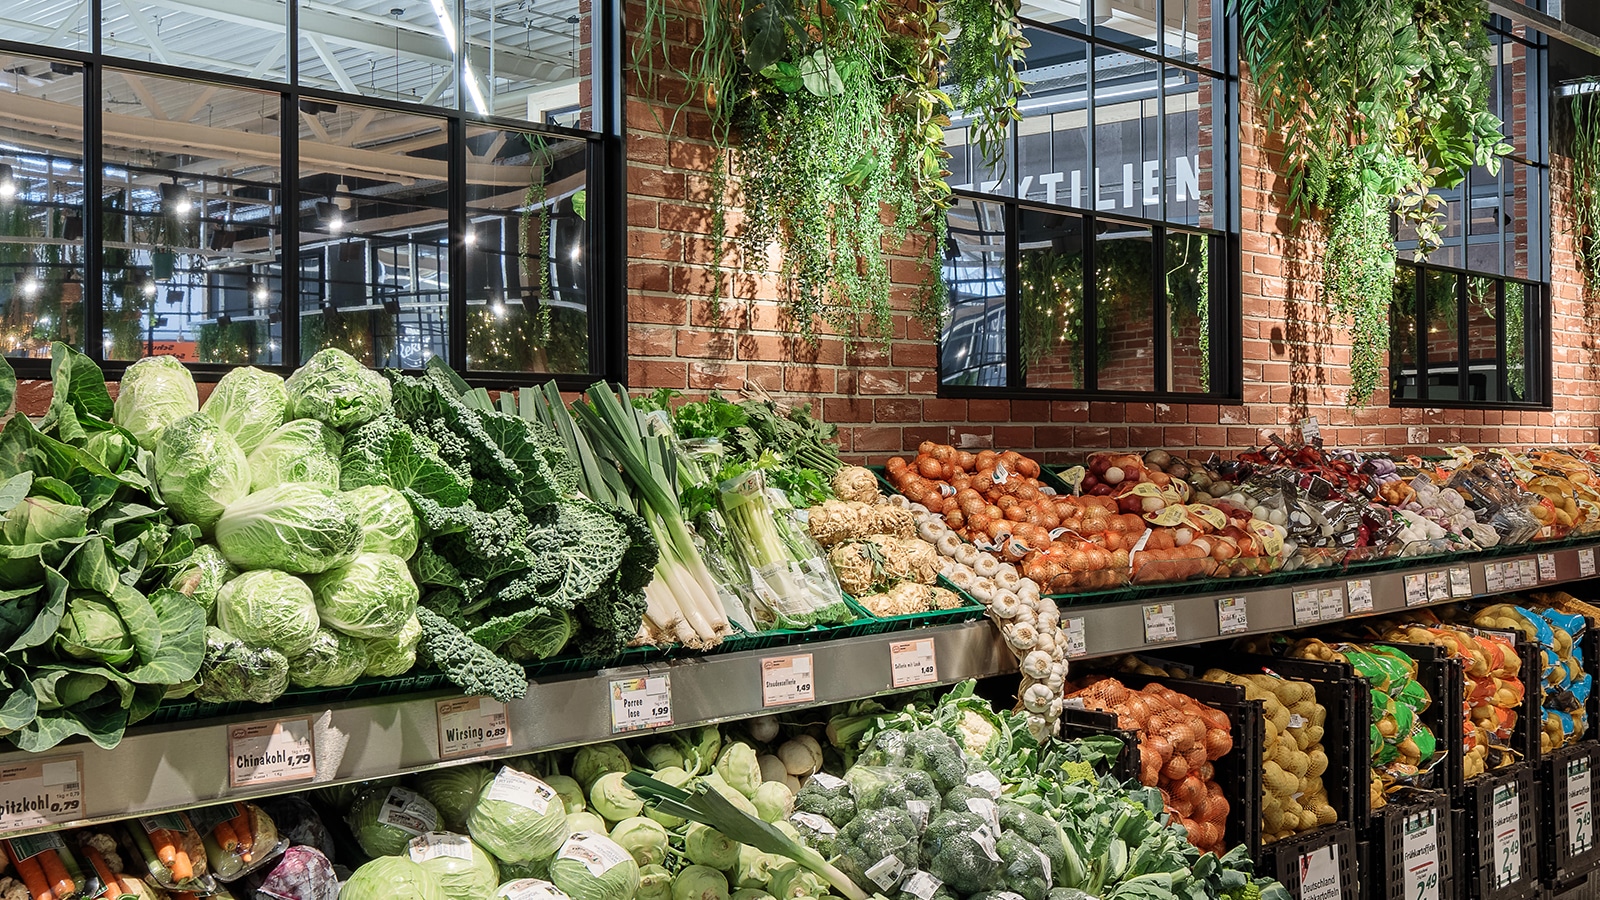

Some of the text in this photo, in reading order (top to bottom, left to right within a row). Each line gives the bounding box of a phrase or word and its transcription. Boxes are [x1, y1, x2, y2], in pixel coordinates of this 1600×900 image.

[921, 666, 934, 674] 1,49
[766, 678, 796, 688] Staudensellerie
[796, 684, 810, 692] 1,49
[624, 698, 643, 708] Porree
[628, 709, 640, 718] lose
[652, 706, 668, 716] 1,99
[446, 726, 483, 742] Wirsing
[486, 728, 506, 738] 0,89
[236, 750, 286, 768] Chinakohl
[287, 754, 311, 767] 1,79
[51, 800, 79, 812] 0,79
[1405, 843, 1435, 861] Frühkartoffeln
[1303, 874, 1335, 894] Deutschland
